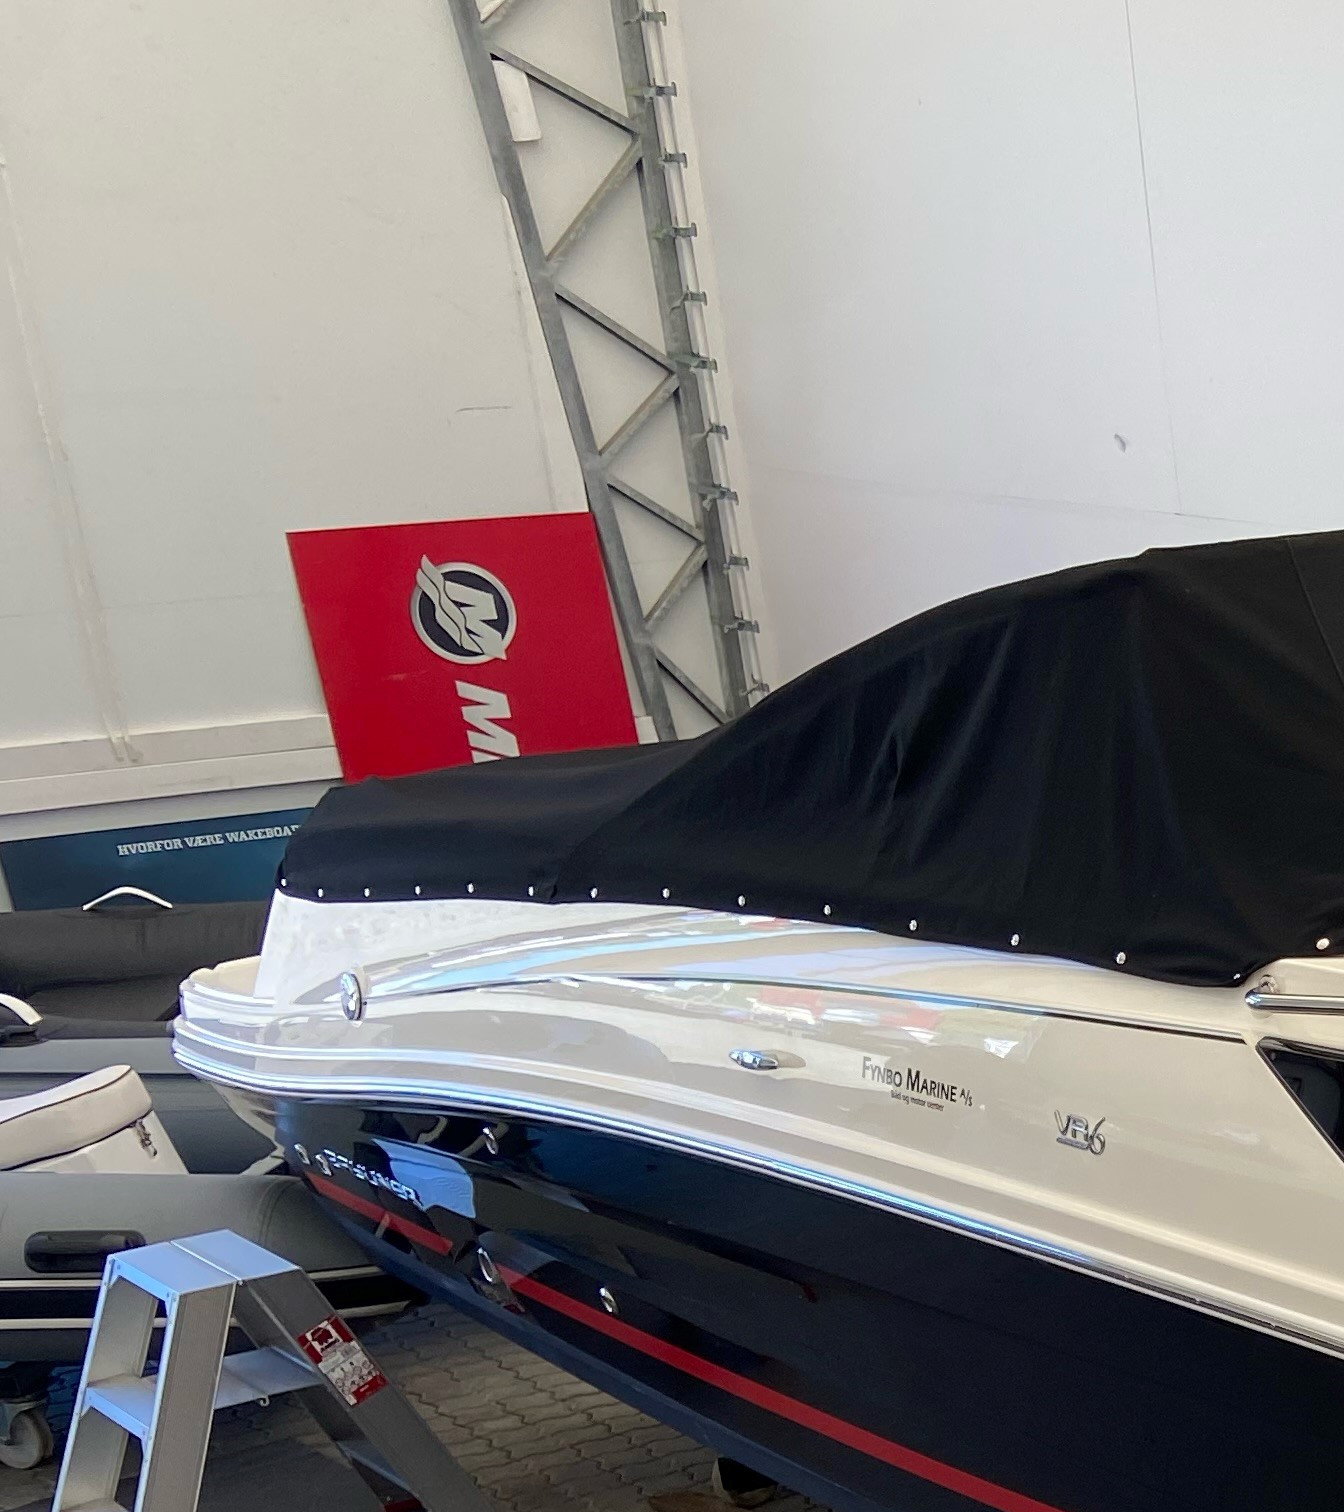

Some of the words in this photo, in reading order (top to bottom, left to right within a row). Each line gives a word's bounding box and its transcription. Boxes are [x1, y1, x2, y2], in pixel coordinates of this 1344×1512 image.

[117, 837, 183, 856] HVORFOR
[183, 833, 225, 848] VÆRE
[861, 1056, 903, 1088] FYNBO
[906, 1067, 958, 1104] MARINE
